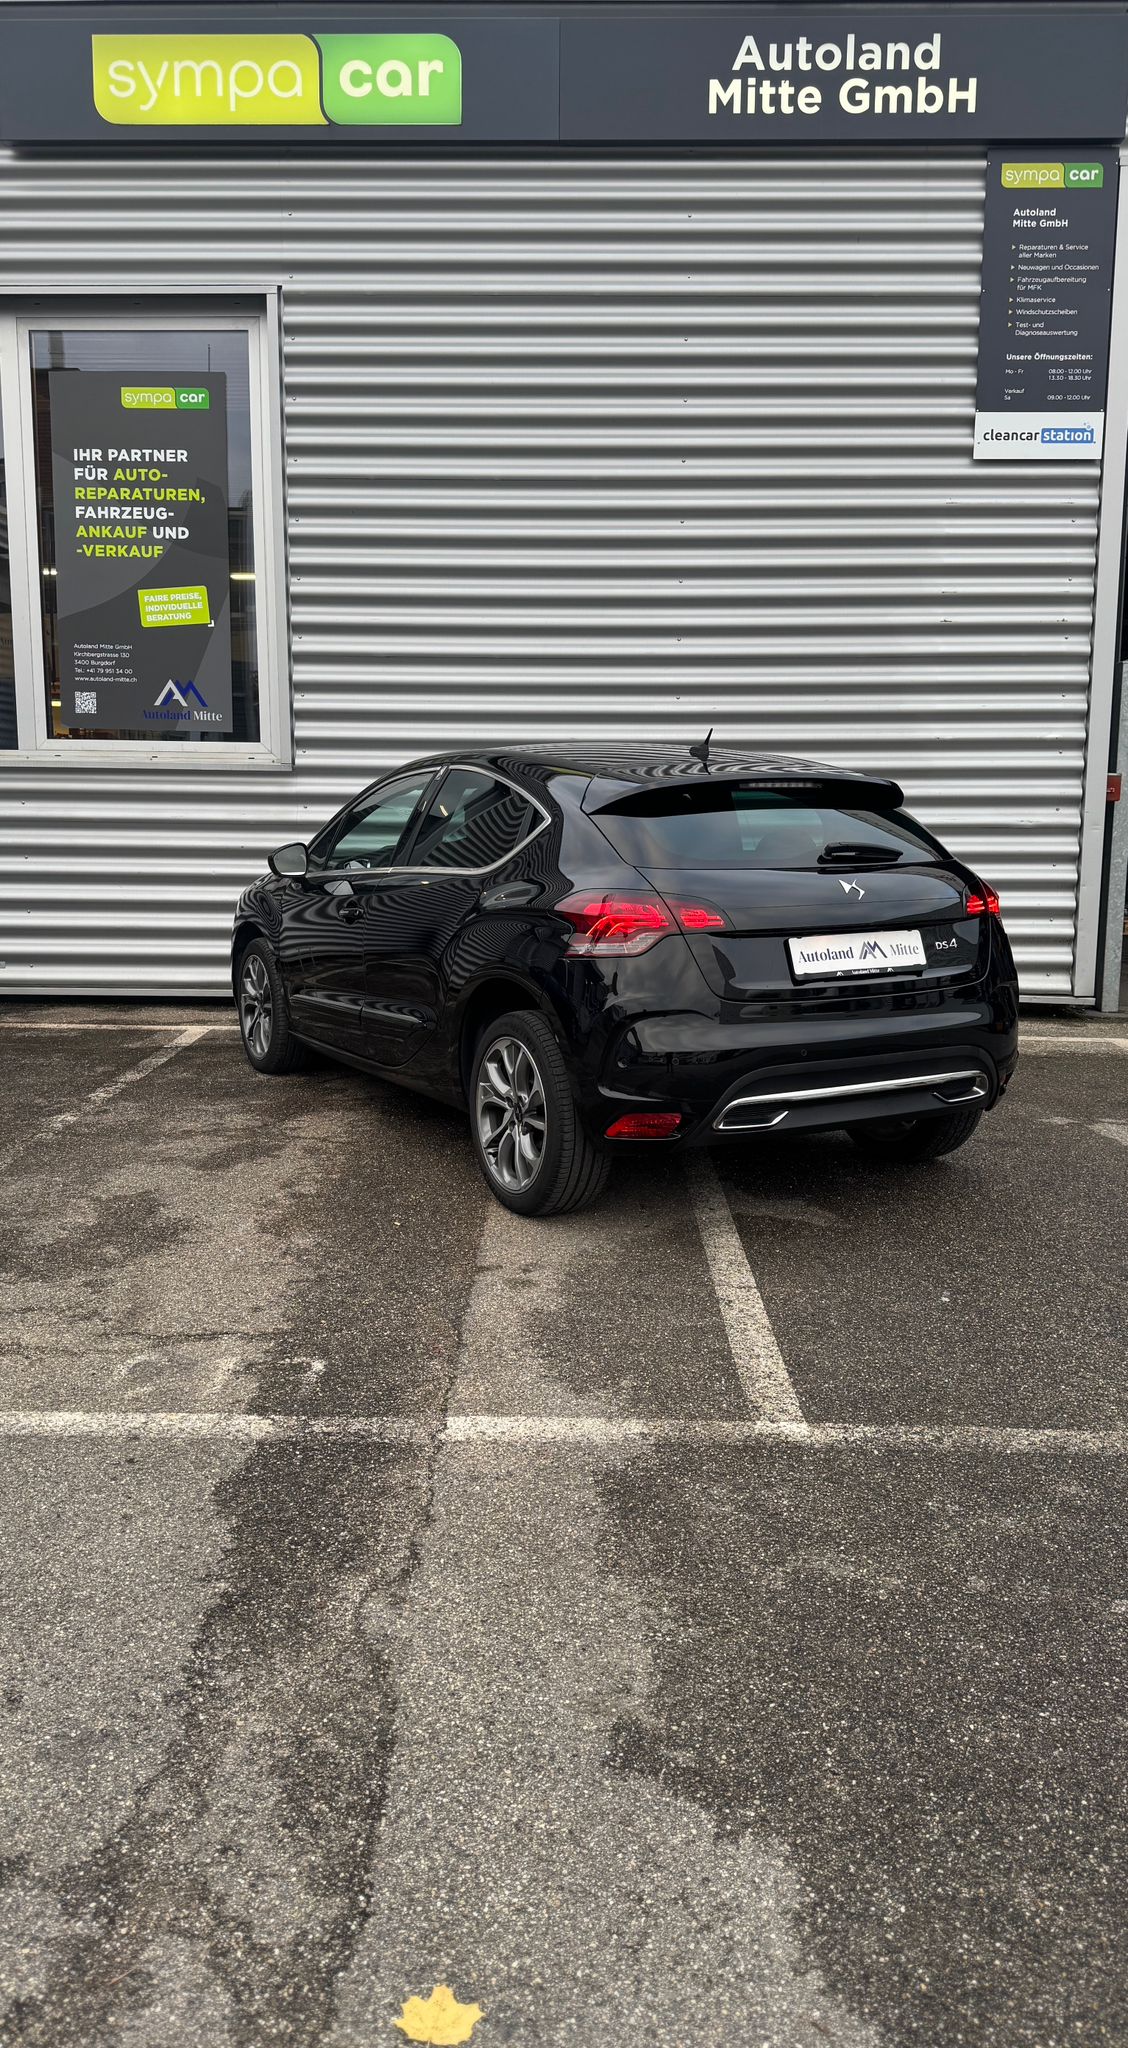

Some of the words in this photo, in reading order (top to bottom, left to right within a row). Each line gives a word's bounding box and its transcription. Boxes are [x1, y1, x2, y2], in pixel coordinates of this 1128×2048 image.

[732, 33, 941, 71] Autoland
[108, 59, 303, 112] sympa
[339, 58, 444, 98] car
[708, 77, 822, 114] Mitte
[838, 76, 978, 114] GmbH
[1005, 170, 1060, 184] sympa
[1069, 169, 1099, 180] car
[1013, 208, 1056, 216] Autoland
[1012, 220, 1036, 228] Mitte
[1039, 219, 1068, 228] GmbH
[1034, 352, 1093, 362] Öffnungszeiten:
[124, 392, 172, 405] sympa
[180, 392, 205, 403] car
[983, 429, 1040, 440] cleancar
[1043, 430, 1091, 441] station
[73, 448, 102, 461] IHR
[108, 449, 188, 462] PARTNER
[74, 465, 108, 480] FÜR
[113, 468, 168, 481] AUTO-
[74, 487, 206, 503] REPARATUREN,
[75, 506, 174, 520] FAHRZEUG-
[76, 526, 148, 538] ANKAUF
[152, 526, 189, 539] UND
[76, 545, 164, 558] -VERKAUF
[170, 592, 202, 601] PREISE,
[145, 602, 203, 612] INDIVIDUELLE
[147, 612, 192, 622] BERATUNG
[143, 710, 191, 720] Autoland
[194, 710, 222, 721] Mitte
[798, 947, 854, 963] Autoland
[890, 944, 919, 957] Mitte
